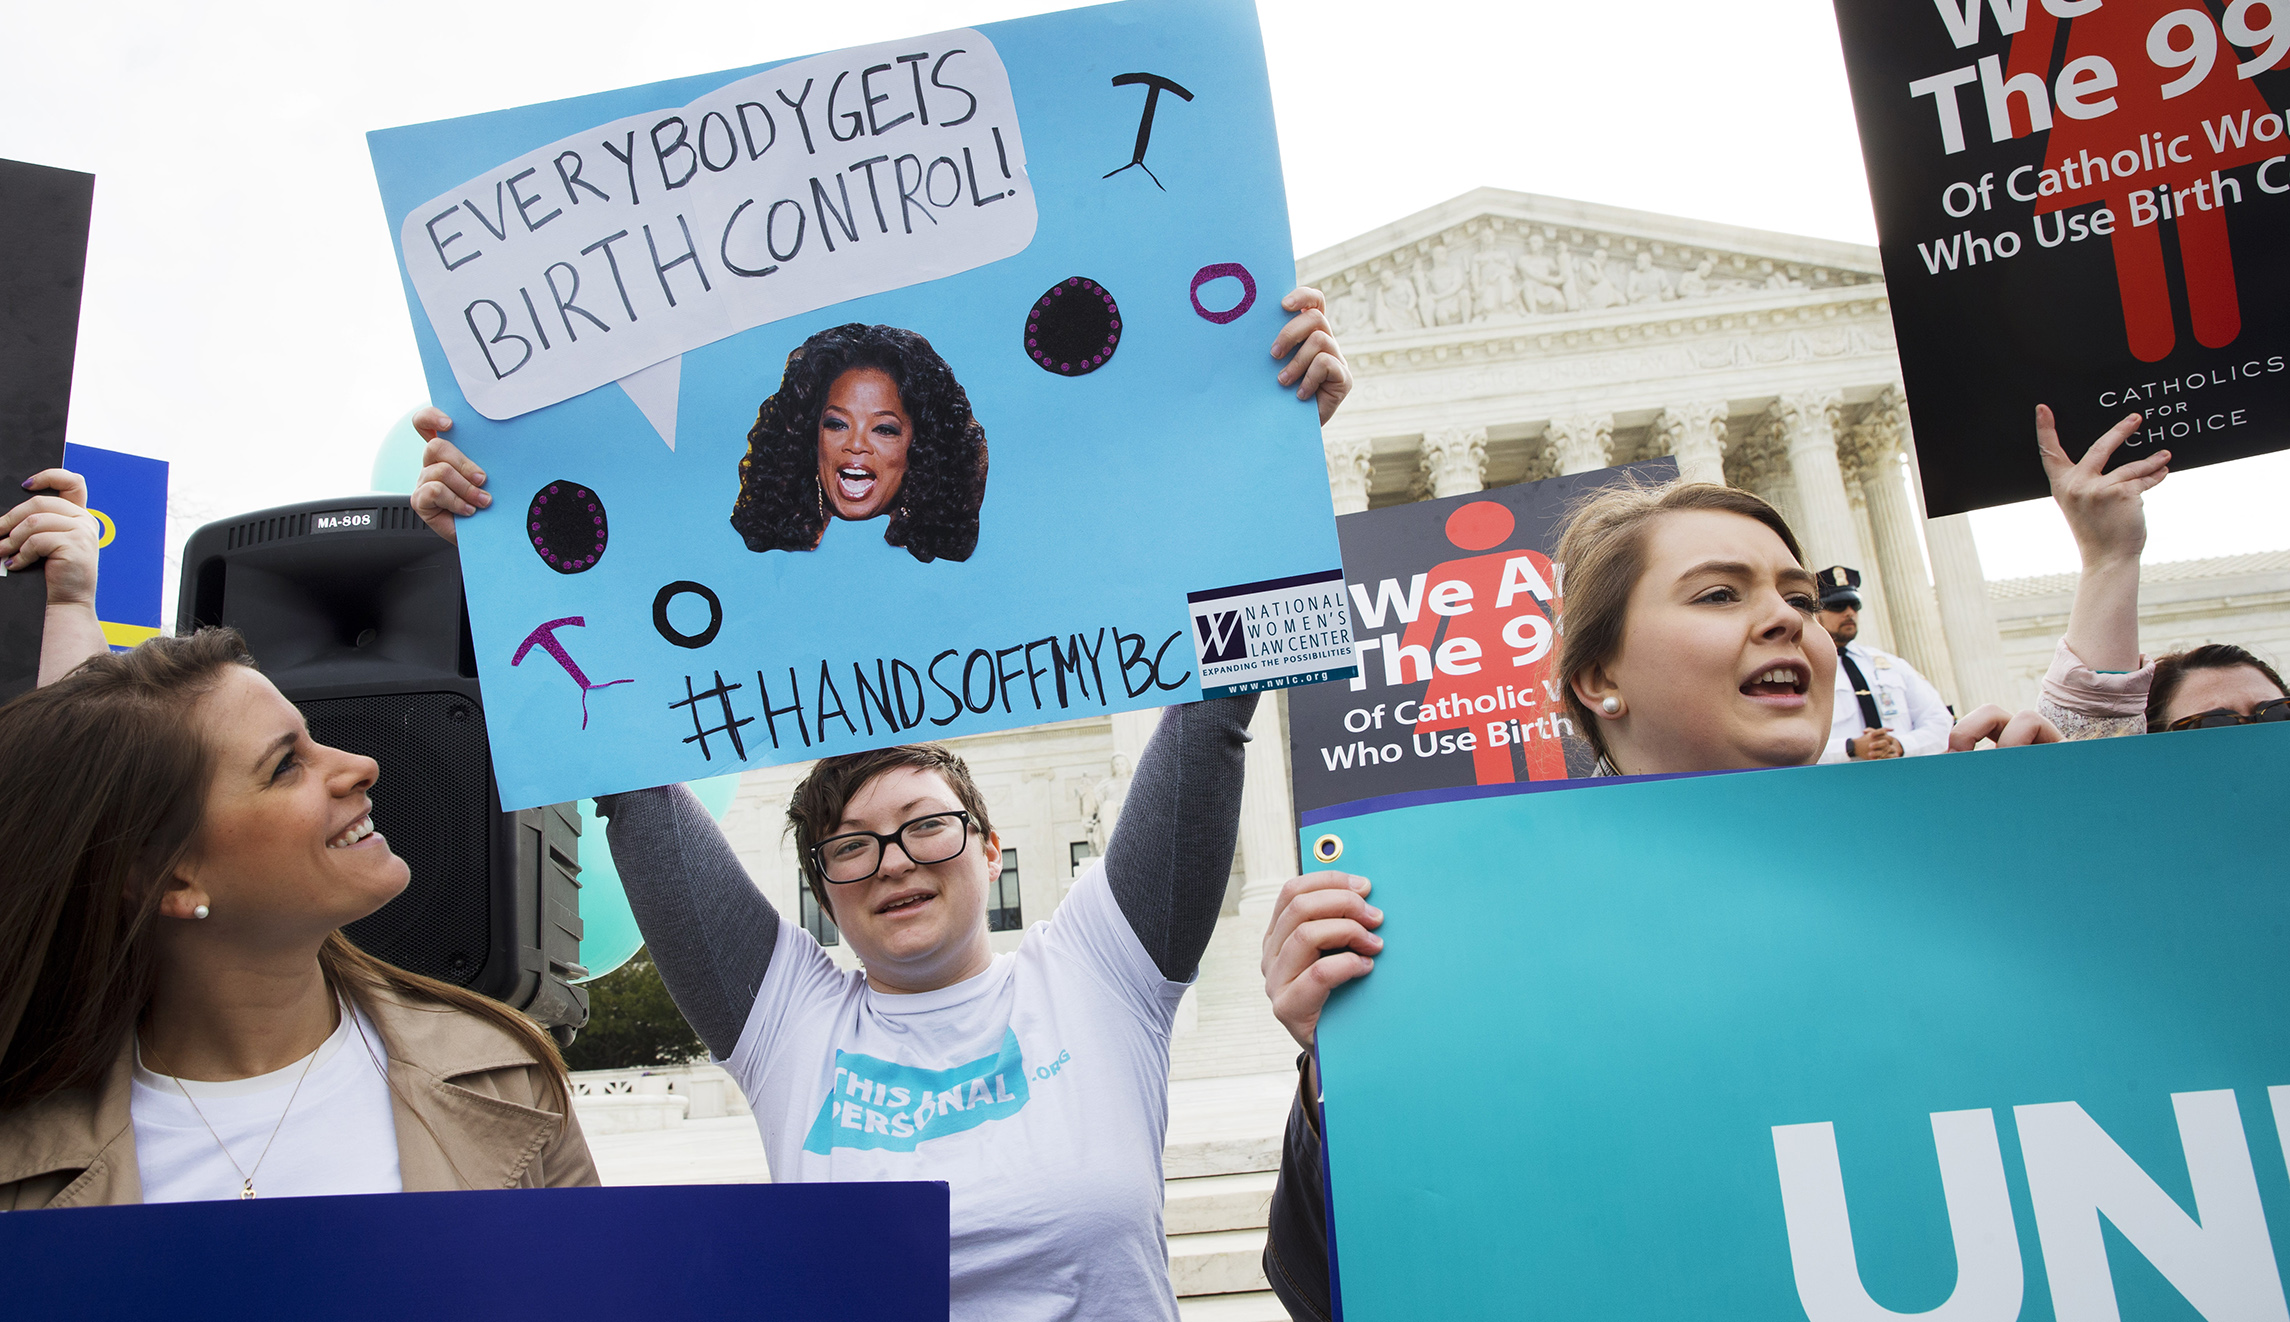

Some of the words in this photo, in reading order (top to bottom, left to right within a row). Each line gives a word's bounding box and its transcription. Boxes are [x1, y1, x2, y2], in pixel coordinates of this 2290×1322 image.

[1909, 53, 2119, 155] The
[1942, 172, 1994, 219] Of
[2007, 131, 2193, 202] Catholic
[2201, 109, 2290, 154] Wo
[1918, 230, 2021, 275] Who
[2033, 208, 2116, 248] Use
[2128, 170, 2242, 228] Birth
[464, 214, 711, 379] BIRTH
[721, 127, 1015, 276] CONTROL!
[2099, 356, 2285, 407] CATHOLICS
[2145, 402, 2187, 419] FOR
[317, 514, 371, 529] MA-808
[1245, 592, 1344, 621] NATIONAL
[1247, 611, 1347, 639] WOMEN'S
[1348, 573, 1474, 629] We
[1202, 662, 1258, 677] EXPANDING
[1261, 658, 1280, 668] THE
[1284, 647, 1352, 664] POSSIBILITIES
[1251, 639, 1283, 657] LAW
[1288, 629, 1350, 651] CENTER
[1228, 671, 1328, 694] www.nwlc.org
[1344, 704, 1385, 733] Of
[1394, 684, 1535, 727] Catholic
[1320, 740, 1403, 772] Who
[1413, 726, 1477, 759] Use
[1487, 712, 1574, 748] Birth
[1772, 1085, 2290, 1322] UN
